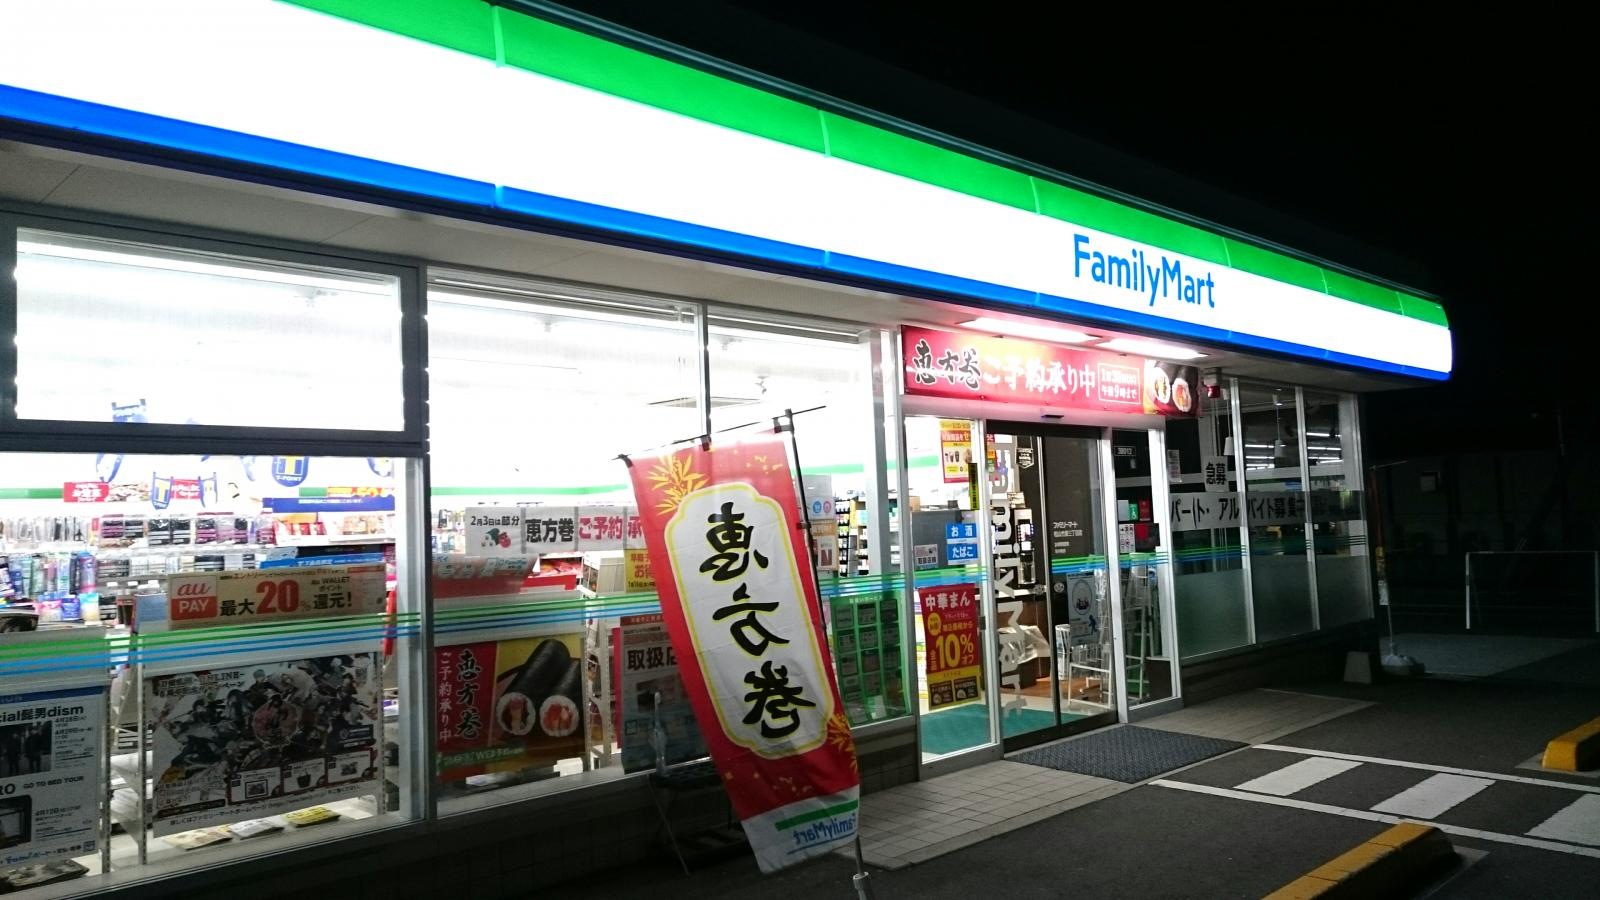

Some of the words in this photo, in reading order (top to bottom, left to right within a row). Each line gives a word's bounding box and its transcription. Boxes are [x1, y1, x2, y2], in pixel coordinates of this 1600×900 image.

[1073, 233, 1215, 308] FamilyMart
[914, 338, 983, 391] 恵方巻
[983, 354, 1096, 397] ご予約承り中
[1205, 461, 1227, 485] 急募
[470, 515, 520, 527] 2月3日は節分
[525, 518, 575, 543] 恵方巻
[951, 525, 973, 537] お酒
[952, 545, 973, 558] たばこ
[177, 582, 210, 596] au
[322, 576, 350, 585] WALLET
[179, 599, 209, 613] PAY
[220, 598, 254, 617] 最大
[925, 591, 971, 611] 中華まん
[438, 651, 452, 743] ご予約承り中
[456, 649, 483, 740] 恵方巻
